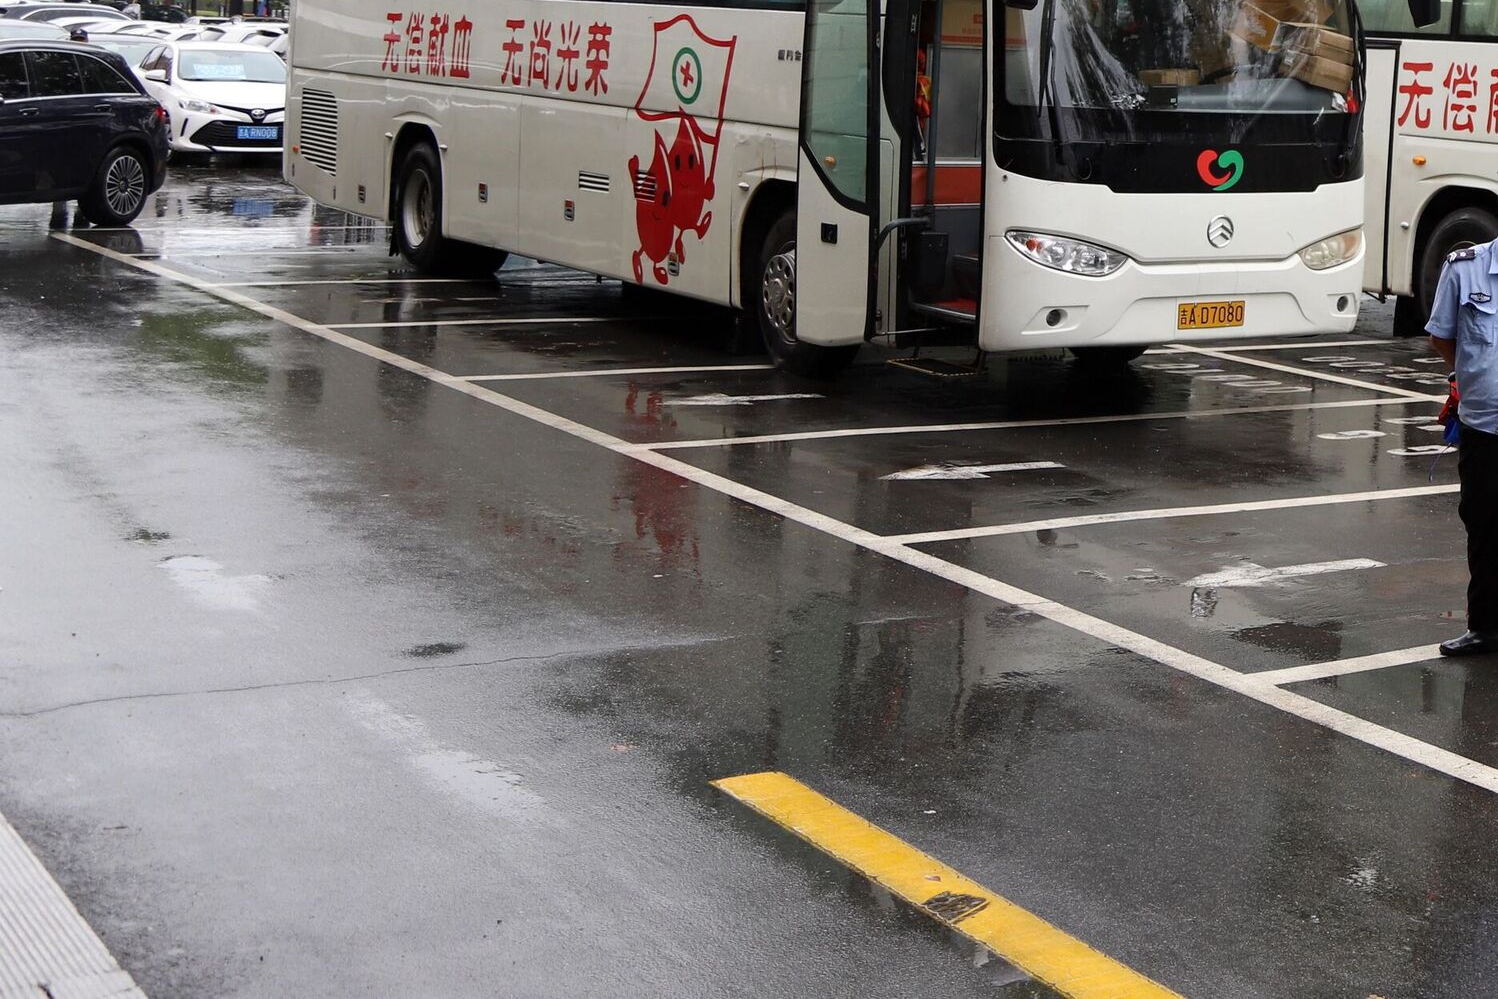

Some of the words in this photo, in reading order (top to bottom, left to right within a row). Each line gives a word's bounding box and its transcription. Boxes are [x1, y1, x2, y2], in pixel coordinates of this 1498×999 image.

[381, 12, 473, 81] 无偿献血
[500, 18, 613, 96] 无尚光荣
